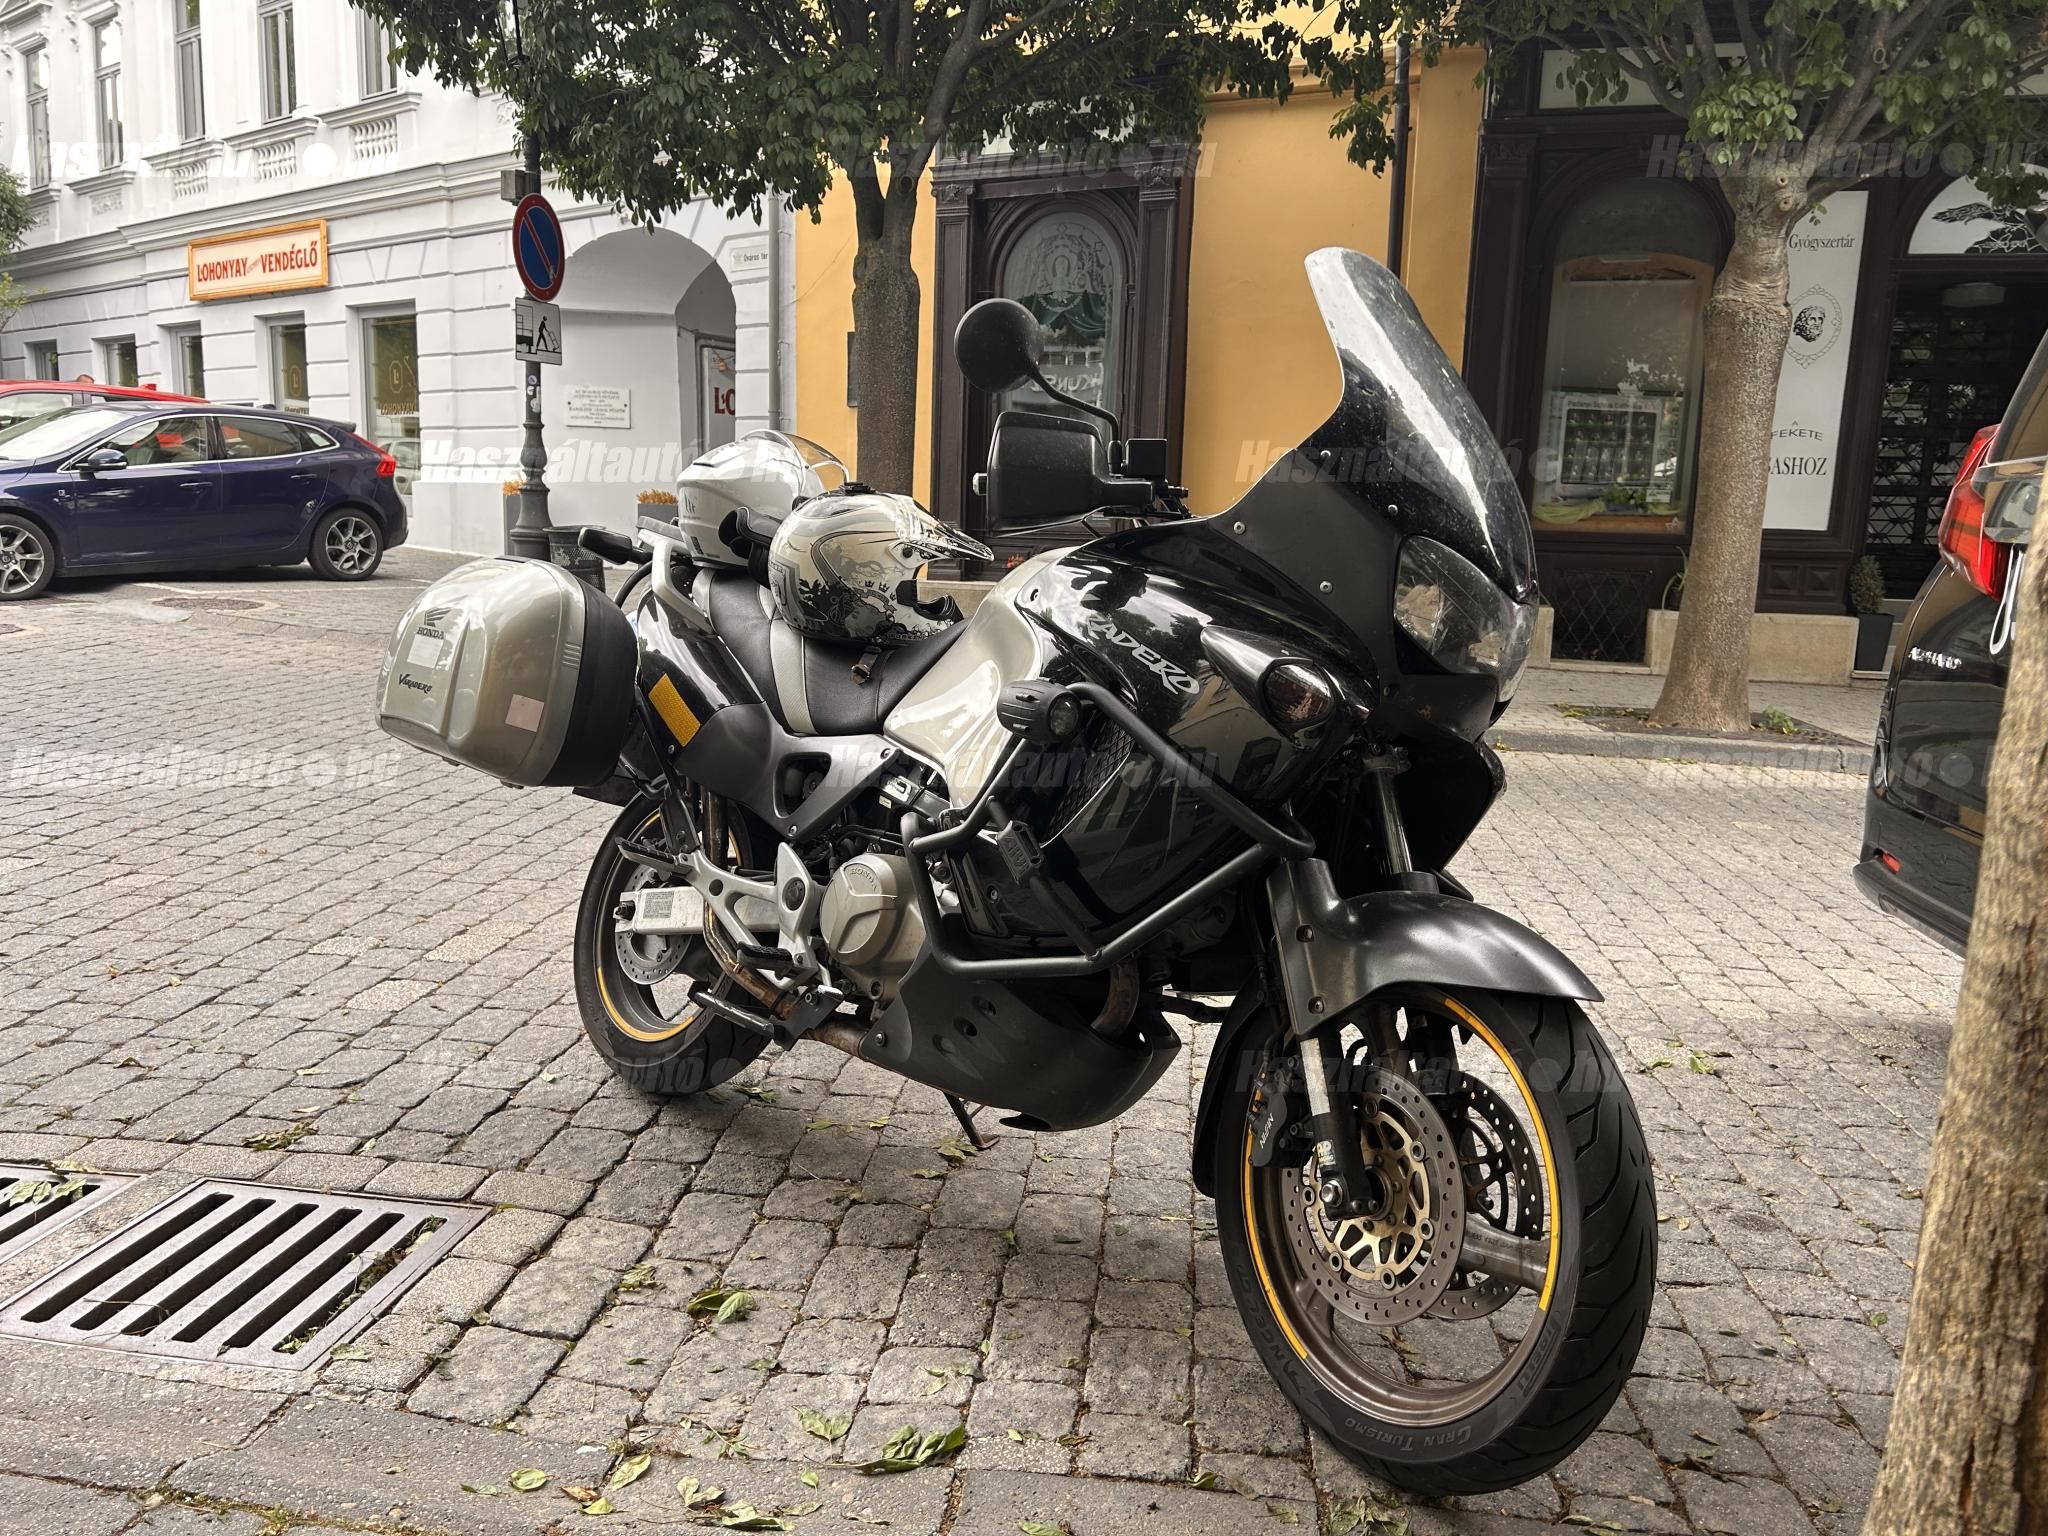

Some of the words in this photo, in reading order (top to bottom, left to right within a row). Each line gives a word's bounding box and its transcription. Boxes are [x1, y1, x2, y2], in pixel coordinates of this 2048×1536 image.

[1788, 233, 1856, 252] Gyógyszertár
[197, 257, 248, 282] LOHONYAY
[260, 240, 318, 273] VENDÉGLŐ
[1770, 428, 1824, 440] FEKETE
[1768, 457, 1828, 476] ASHOZ
[416, 626, 446, 640] HONDA
[849, 866, 879, 893] HONDA
[1259, 1112, 1275, 1150] NISSIN
[1344, 1417, 1414, 1451] TURISMO
[1423, 1425, 1472, 1446] GRAN
